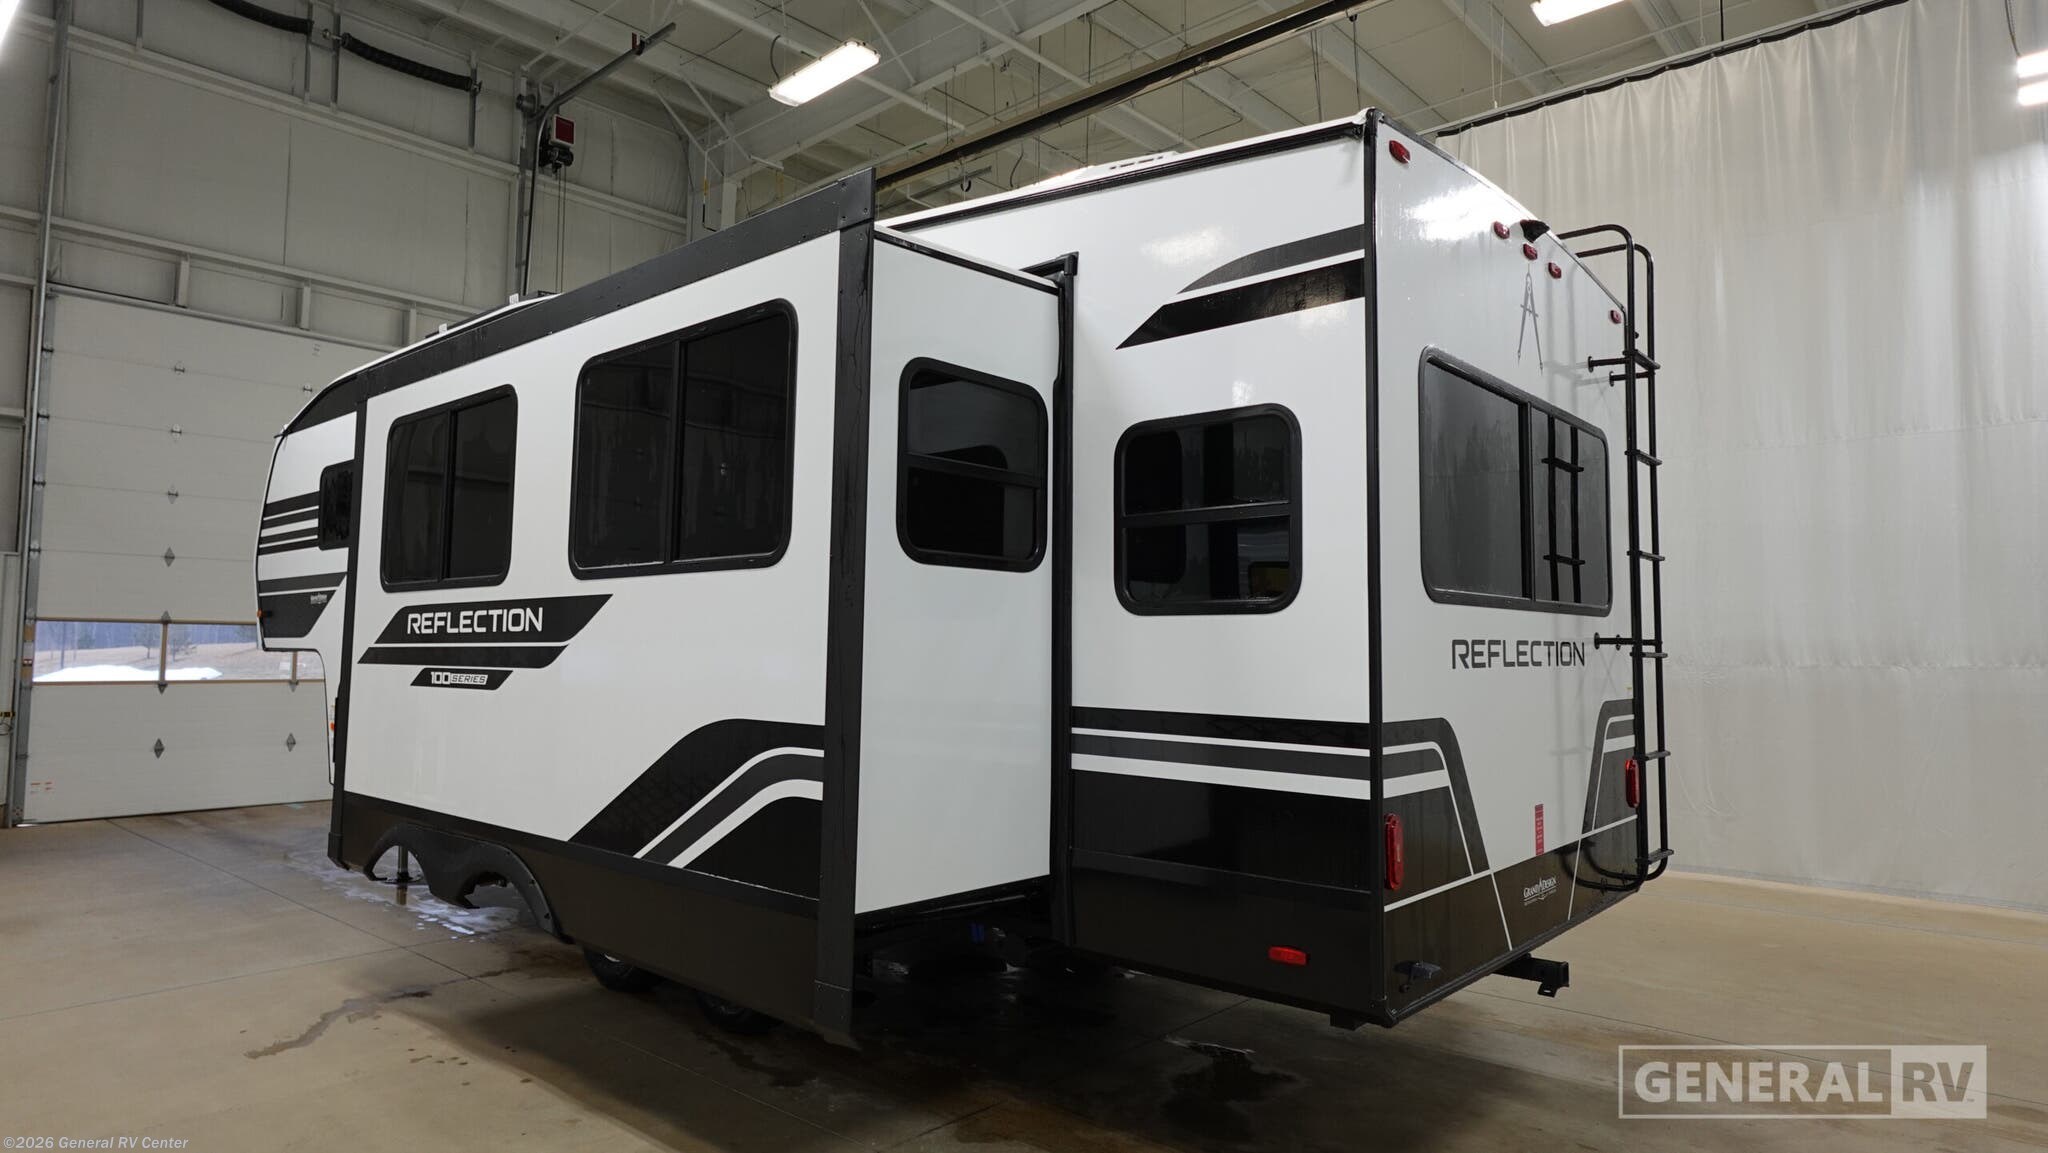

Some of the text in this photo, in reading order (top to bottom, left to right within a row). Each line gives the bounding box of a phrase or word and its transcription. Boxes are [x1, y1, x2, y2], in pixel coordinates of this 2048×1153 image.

[407, 606, 544, 634] REFLECTION
[1452, 639, 1585, 669] REFLECTION
[431, 671, 487, 685] 100 SERIES
